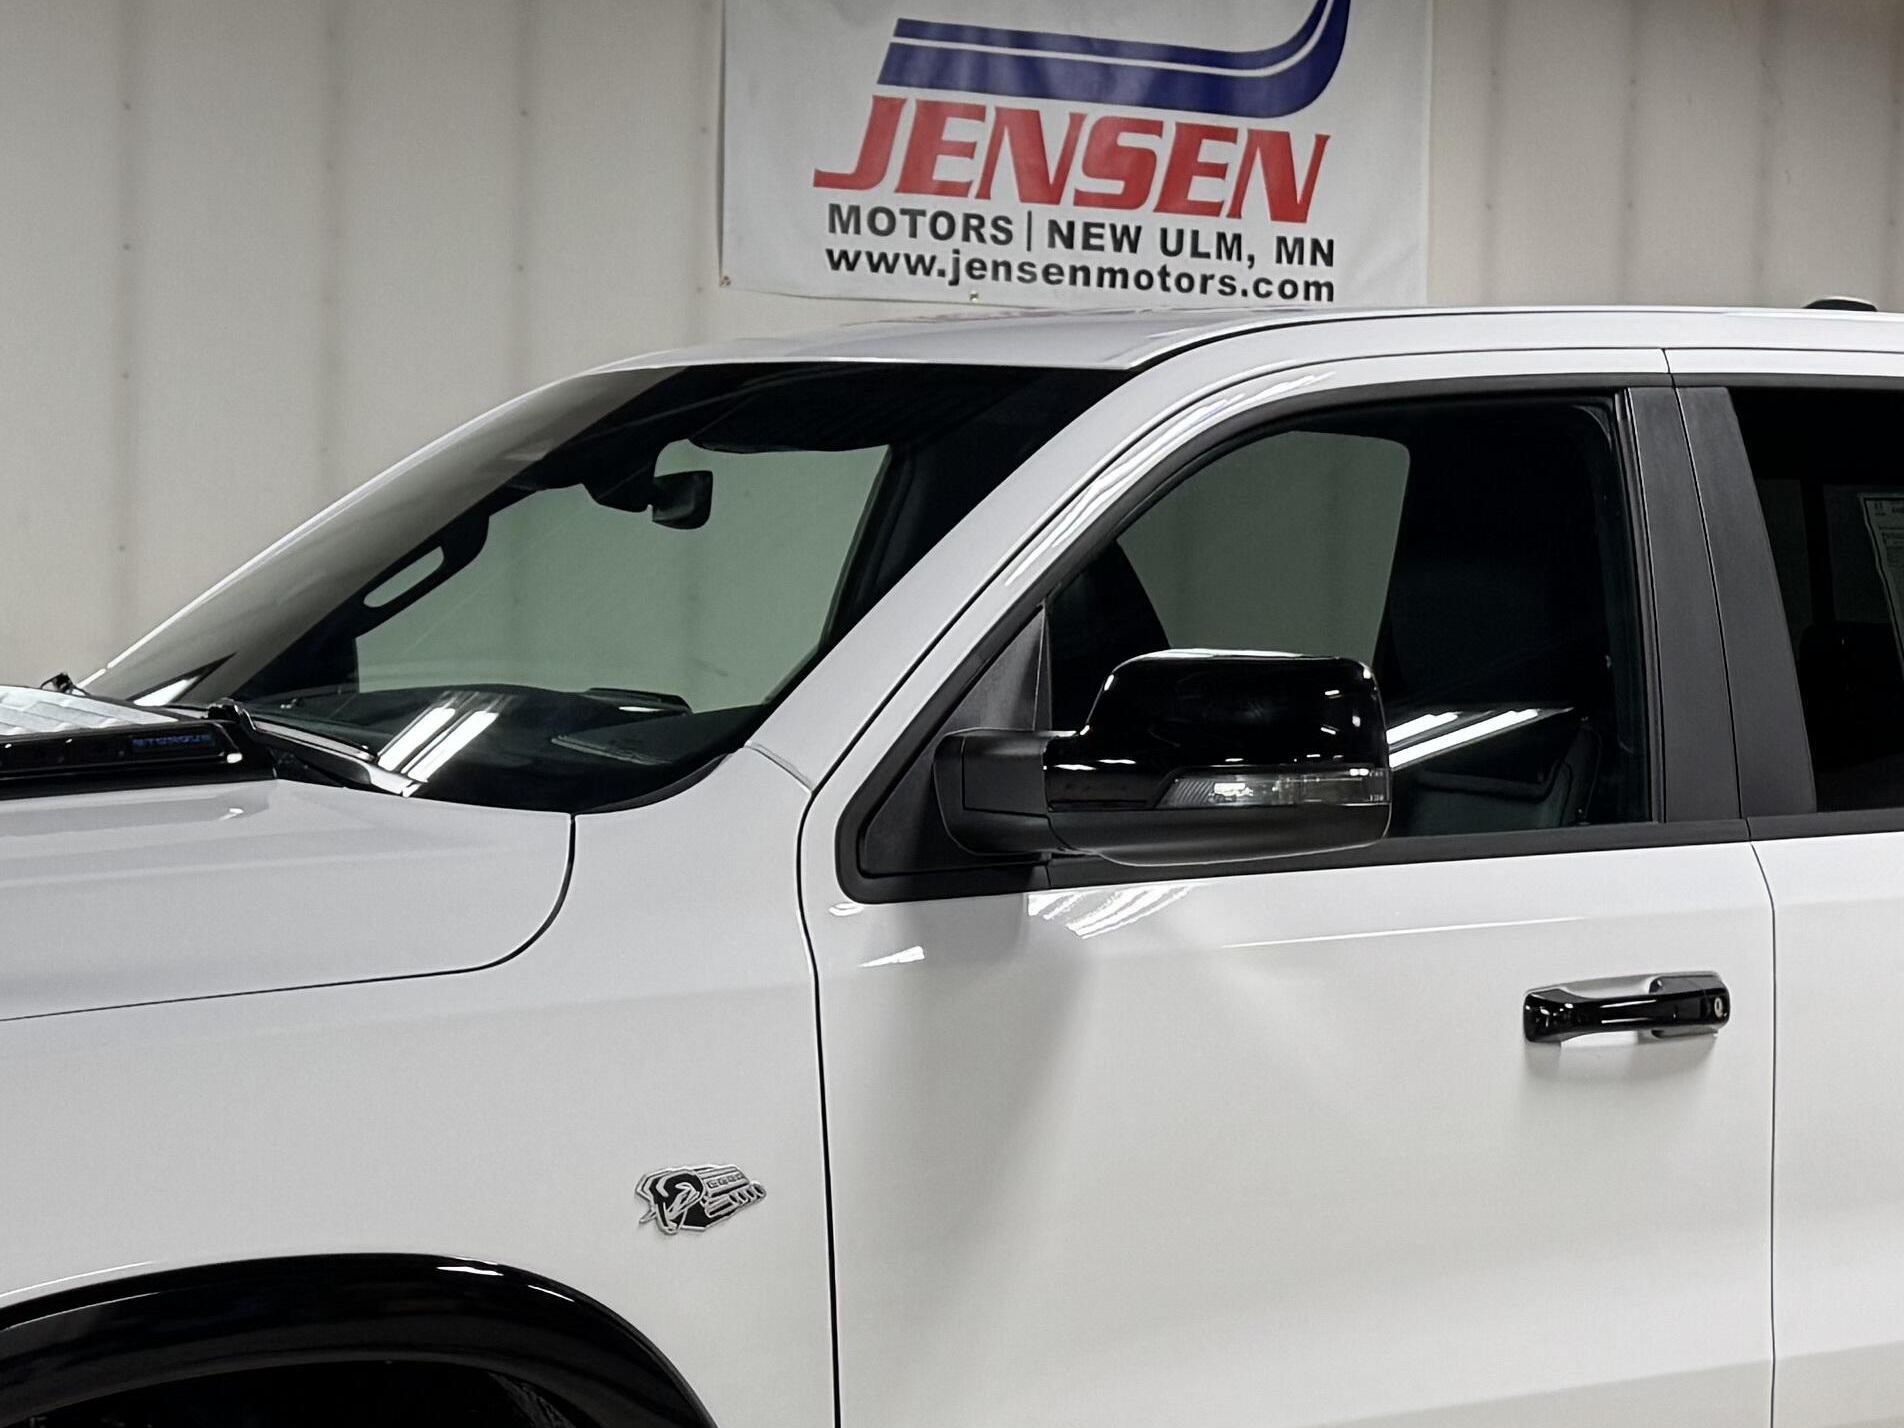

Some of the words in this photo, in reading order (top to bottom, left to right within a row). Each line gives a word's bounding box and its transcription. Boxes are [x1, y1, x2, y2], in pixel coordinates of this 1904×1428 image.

[813, 95, 1331, 224] JENSEN
[827, 202, 1014, 247] MOTORS
[1047, 218, 1143, 255] NEW
[1159, 226, 1256, 270] ULM,
[1274, 235, 1335, 268] MN
[824, 247, 1335, 303] www.jensenmotors.com
